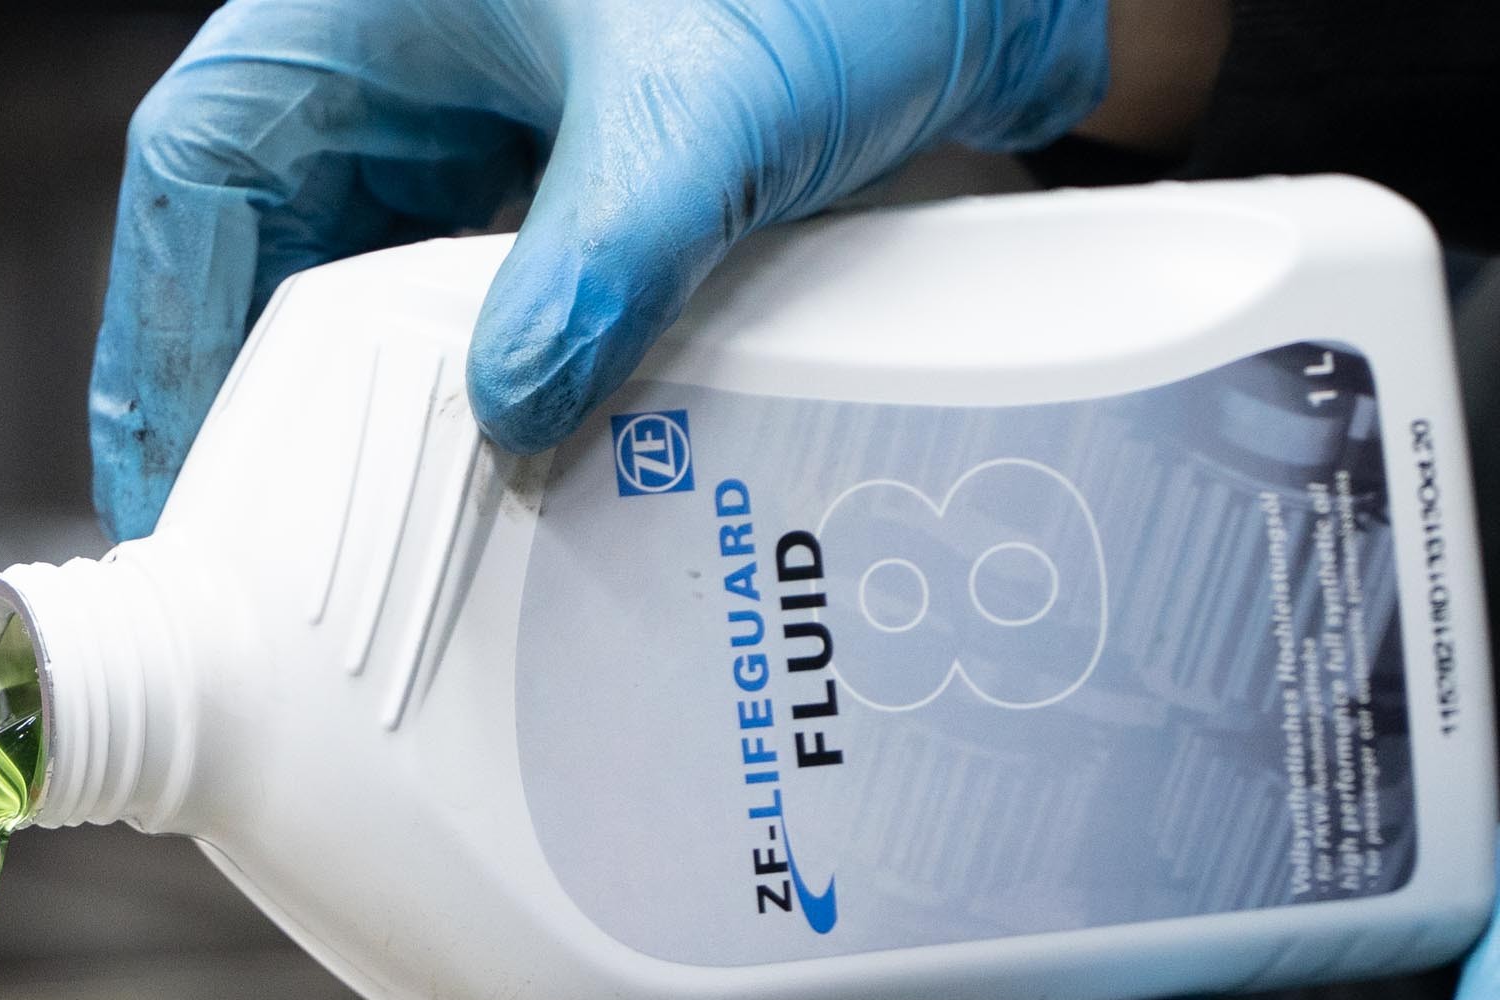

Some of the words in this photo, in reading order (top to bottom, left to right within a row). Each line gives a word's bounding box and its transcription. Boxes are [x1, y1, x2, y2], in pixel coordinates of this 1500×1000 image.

[1304, 350, 1334, 377] L
[1308, 389, 1338, 408] 1
[1307, 482, 1331, 514] oil
[813, 457, 1109, 712] 8
[1314, 519, 1344, 627] synthetic
[775, 529, 844, 768] FLUID
[1322, 632, 1346, 673] full
[714, 478, 793, 914] ZF-LIFEGUARD
[1332, 679, 1362, 832] performance
[1338, 837, 1364, 890] high
